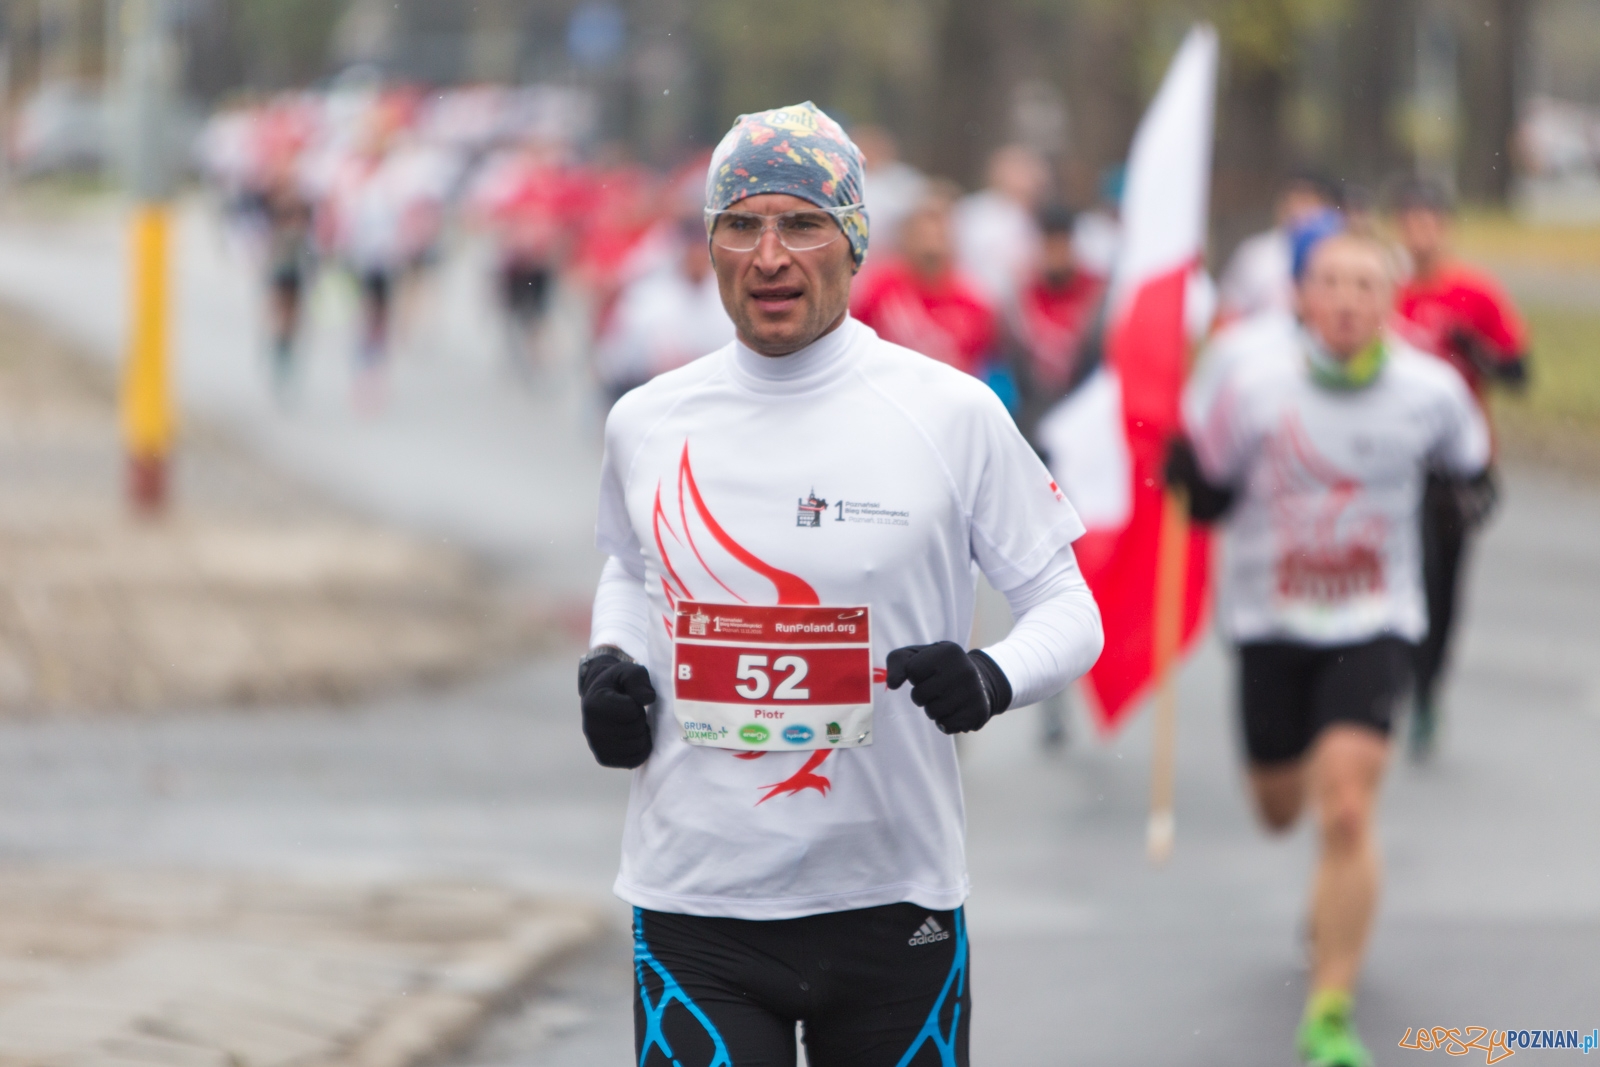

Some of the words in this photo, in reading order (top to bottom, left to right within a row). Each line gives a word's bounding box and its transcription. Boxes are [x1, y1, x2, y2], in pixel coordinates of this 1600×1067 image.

[834, 500, 845, 521] 1
[713, 616, 722, 632] 1
[775, 622, 856, 634] RunPoland.org
[678, 664, 692, 680] B
[734, 654, 810, 701] 52
[754, 709, 785, 719] Piotr
[684, 721, 713, 731] GRUPA
[908, 931, 950, 947] adidas
